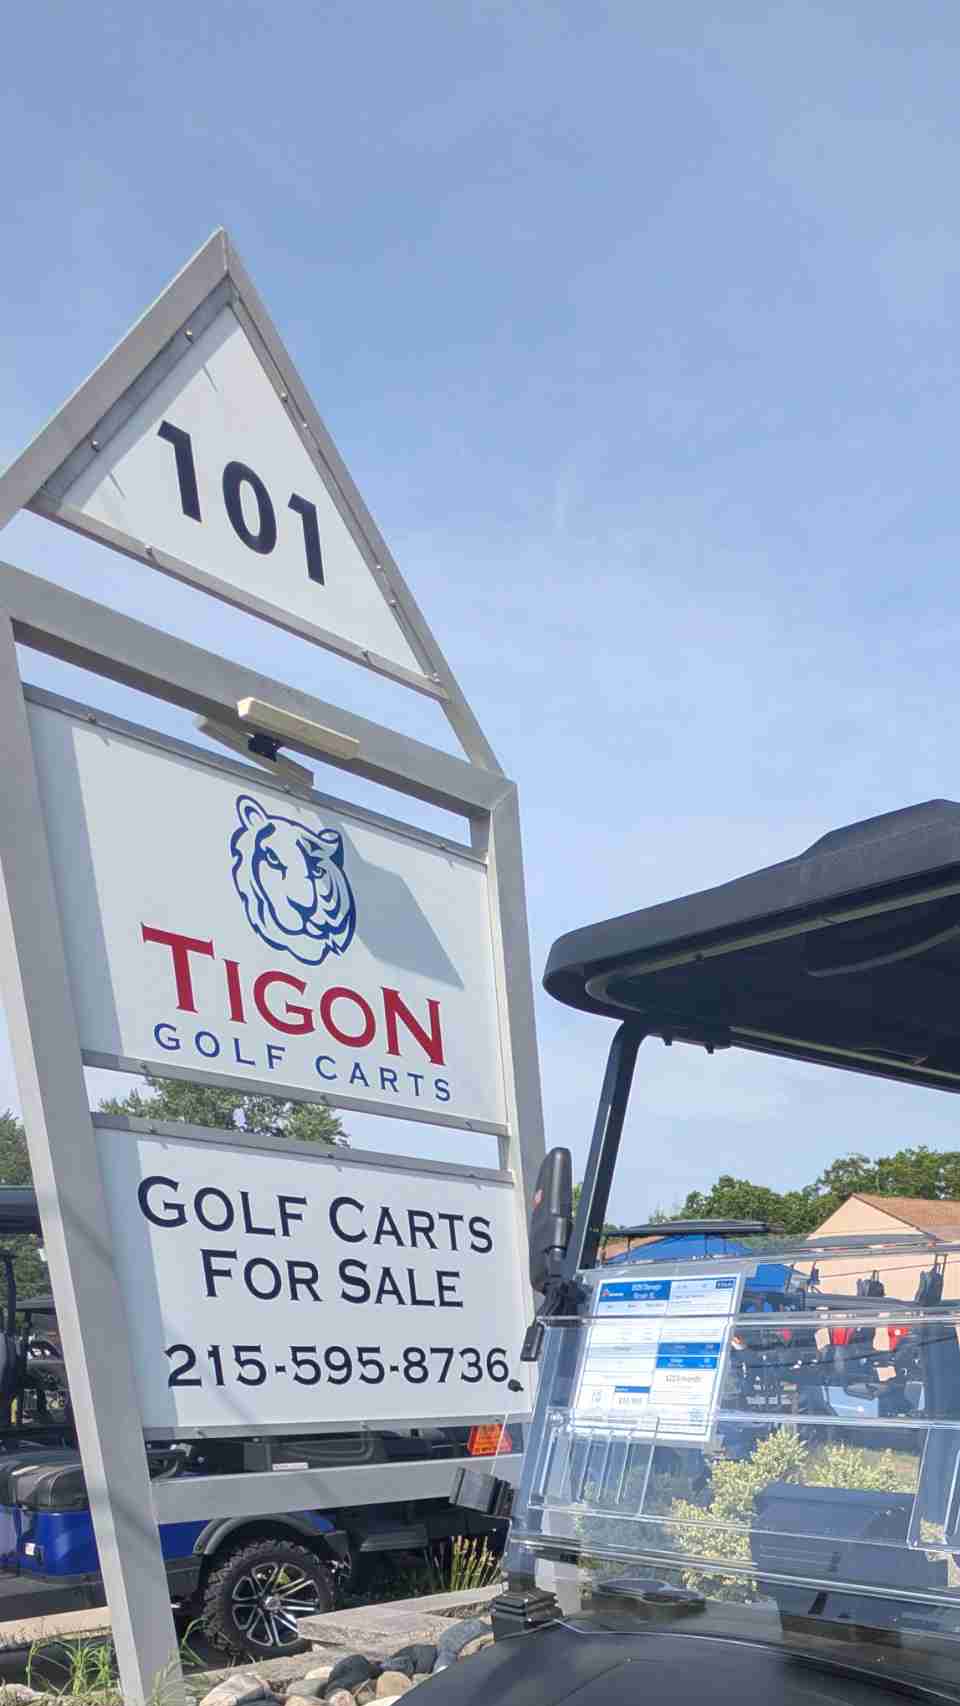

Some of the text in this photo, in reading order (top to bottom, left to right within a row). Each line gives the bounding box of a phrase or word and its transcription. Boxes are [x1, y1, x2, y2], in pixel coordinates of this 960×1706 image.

[157, 420, 325, 586] 101
[140, 922, 446, 1066] TIGON
[153, 1023, 451, 1102] GOLF CARTS
[137, 1175, 493, 1254] GOLF CARTS
[199, 1248, 464, 1308] FOR SALE
[164, 1343, 509, 1389] 215-595-8736
